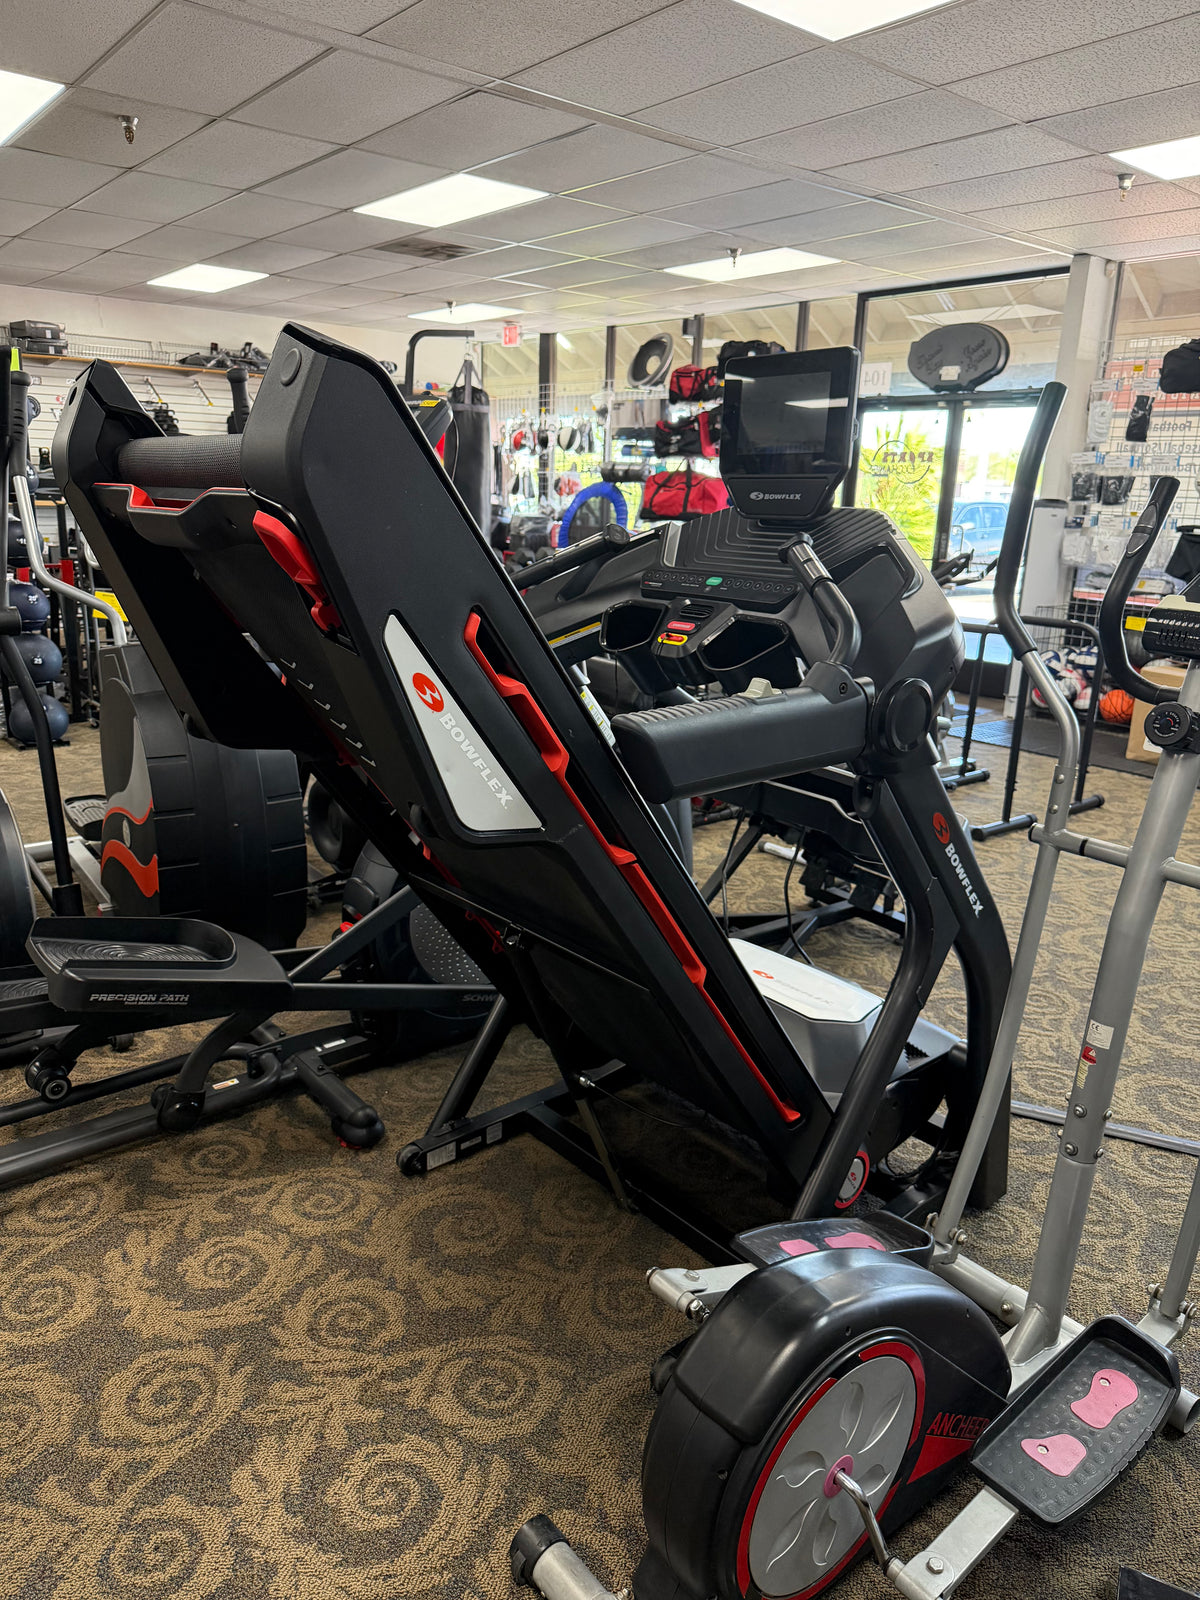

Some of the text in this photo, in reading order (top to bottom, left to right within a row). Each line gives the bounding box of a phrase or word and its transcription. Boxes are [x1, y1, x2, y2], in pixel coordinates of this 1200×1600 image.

[763, 493, 801, 501] BOWFLEX
[438, 712, 514, 807] BOWFLEX
[944, 842, 984, 919] BOWFLEX
[89, 993, 190, 1002] PRECISION PATH
